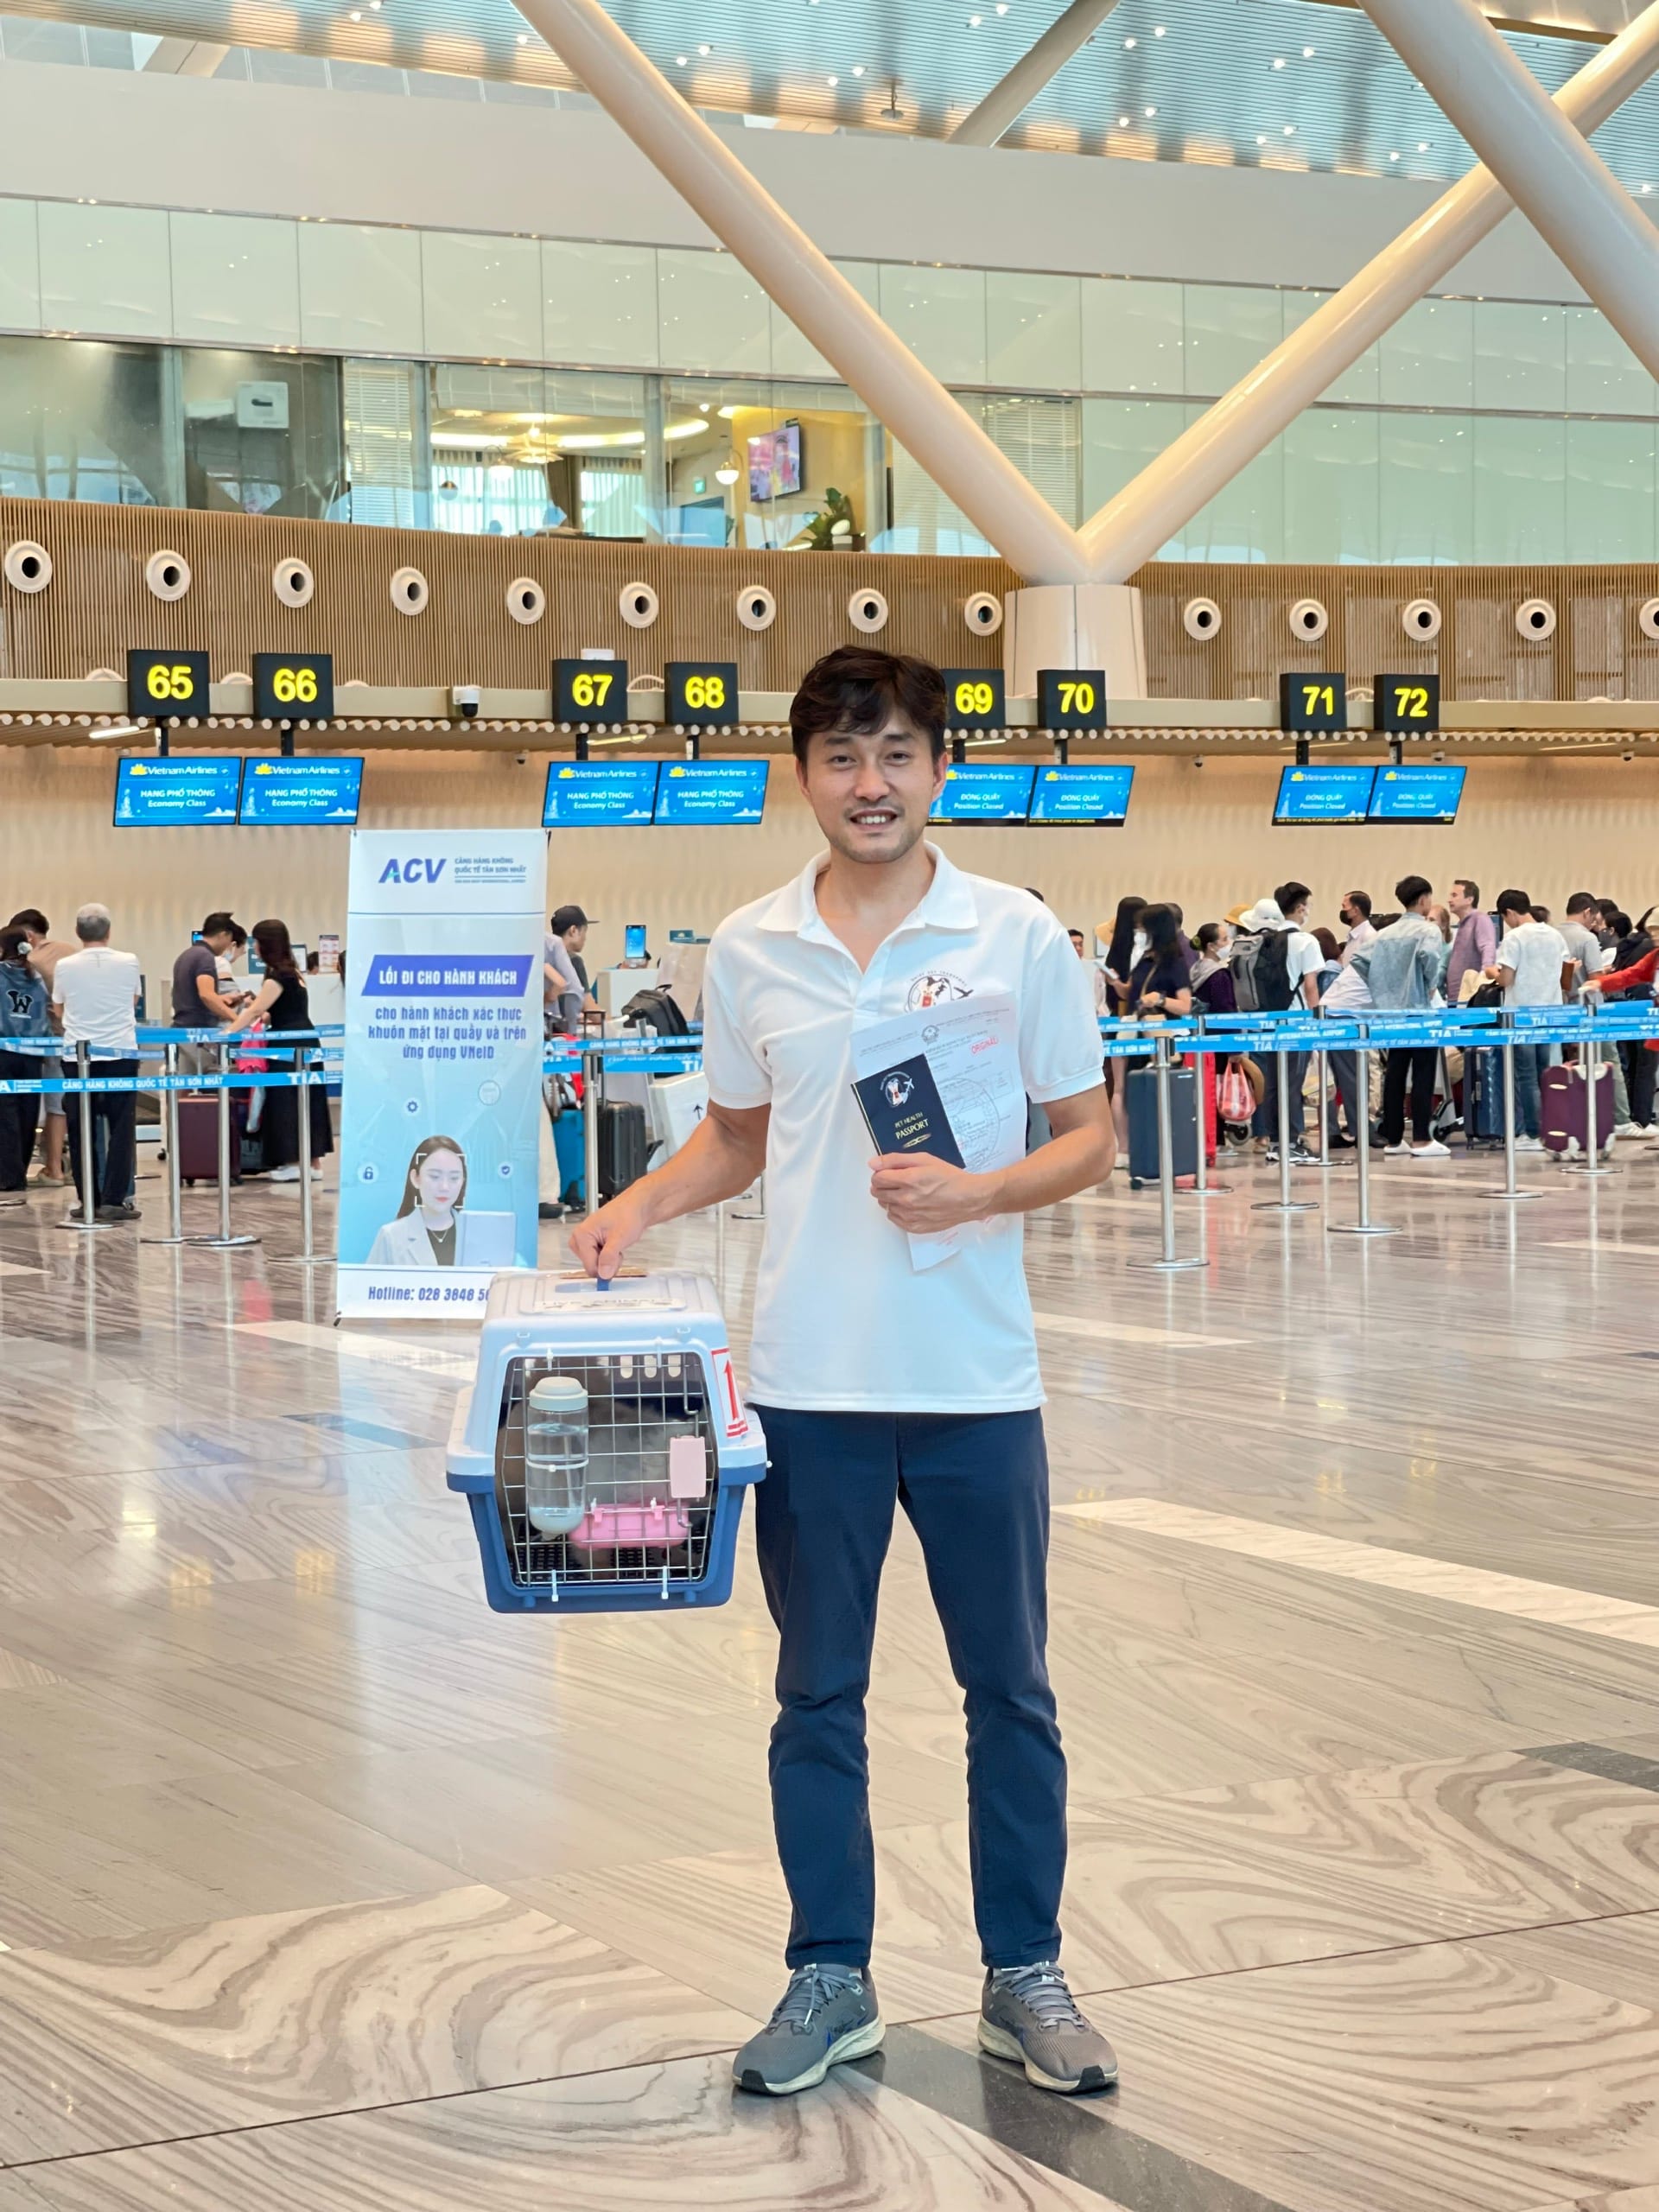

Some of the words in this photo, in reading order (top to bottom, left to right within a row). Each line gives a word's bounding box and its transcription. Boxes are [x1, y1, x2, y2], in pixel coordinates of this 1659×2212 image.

[147, 664, 194, 700] 65
[273, 668, 318, 702] 66
[572, 673, 613, 706] 67
[685, 676, 725, 709] 68
[955, 683, 993, 714] 69
[1058, 683, 1094, 714] 70
[1302, 686, 1334, 715] 71
[1394, 688, 1428, 717] 72
[146, 766, 184, 775] Vietnam
[184, 766, 218, 774] Airlines
[272, 766, 308, 775] Vietnam
[308, 766, 340, 774] Airlines
[575, 770, 607, 778] Vietnam
[607, 769, 637, 778] Airlines
[685, 769, 718, 777] Vietnam
[718, 769, 747, 777] Airlines
[148, 800, 184, 809] Economy
[272, 799, 308, 808] Economy
[574, 802, 606, 810] Economy
[684, 801, 716, 809] Economy
[378, 858, 447, 884] ACV
[379, 965, 398, 985] LỐI
[401, 970, 414, 985] ĐI
[417, 970, 441, 985] CHO
[444, 968, 475, 985] HÀNH
[479, 968, 517, 985] KHÁCH
[7, 990, 33, 1014] W
[375, 1007, 397, 1020] cho
[434, 1006, 469, 1020] khách
[474, 1006, 494, 1020] xác
[498, 1007, 522, 1023] thực
[1648, 1007, 1659, 1016] TI
[435, 1026, 449, 1042] tại
[486, 1025, 499, 1039] và
[504, 1026, 526, 1039] trên
[403, 1044, 424, 1059] ứng
[428, 1046, 456, 1062] dụng
[461, 1046, 494, 1059] VNeID
[1253, 1042, 1273, 1051] TIA
[286, 1072, 321, 1085] TIA
[895, 1119, 929, 1140] PASSPORT
[368, 1286, 415, 1300] Hotline:
[418, 1287, 441, 1301] 028
[444, 1288, 475, 1301] 3848
